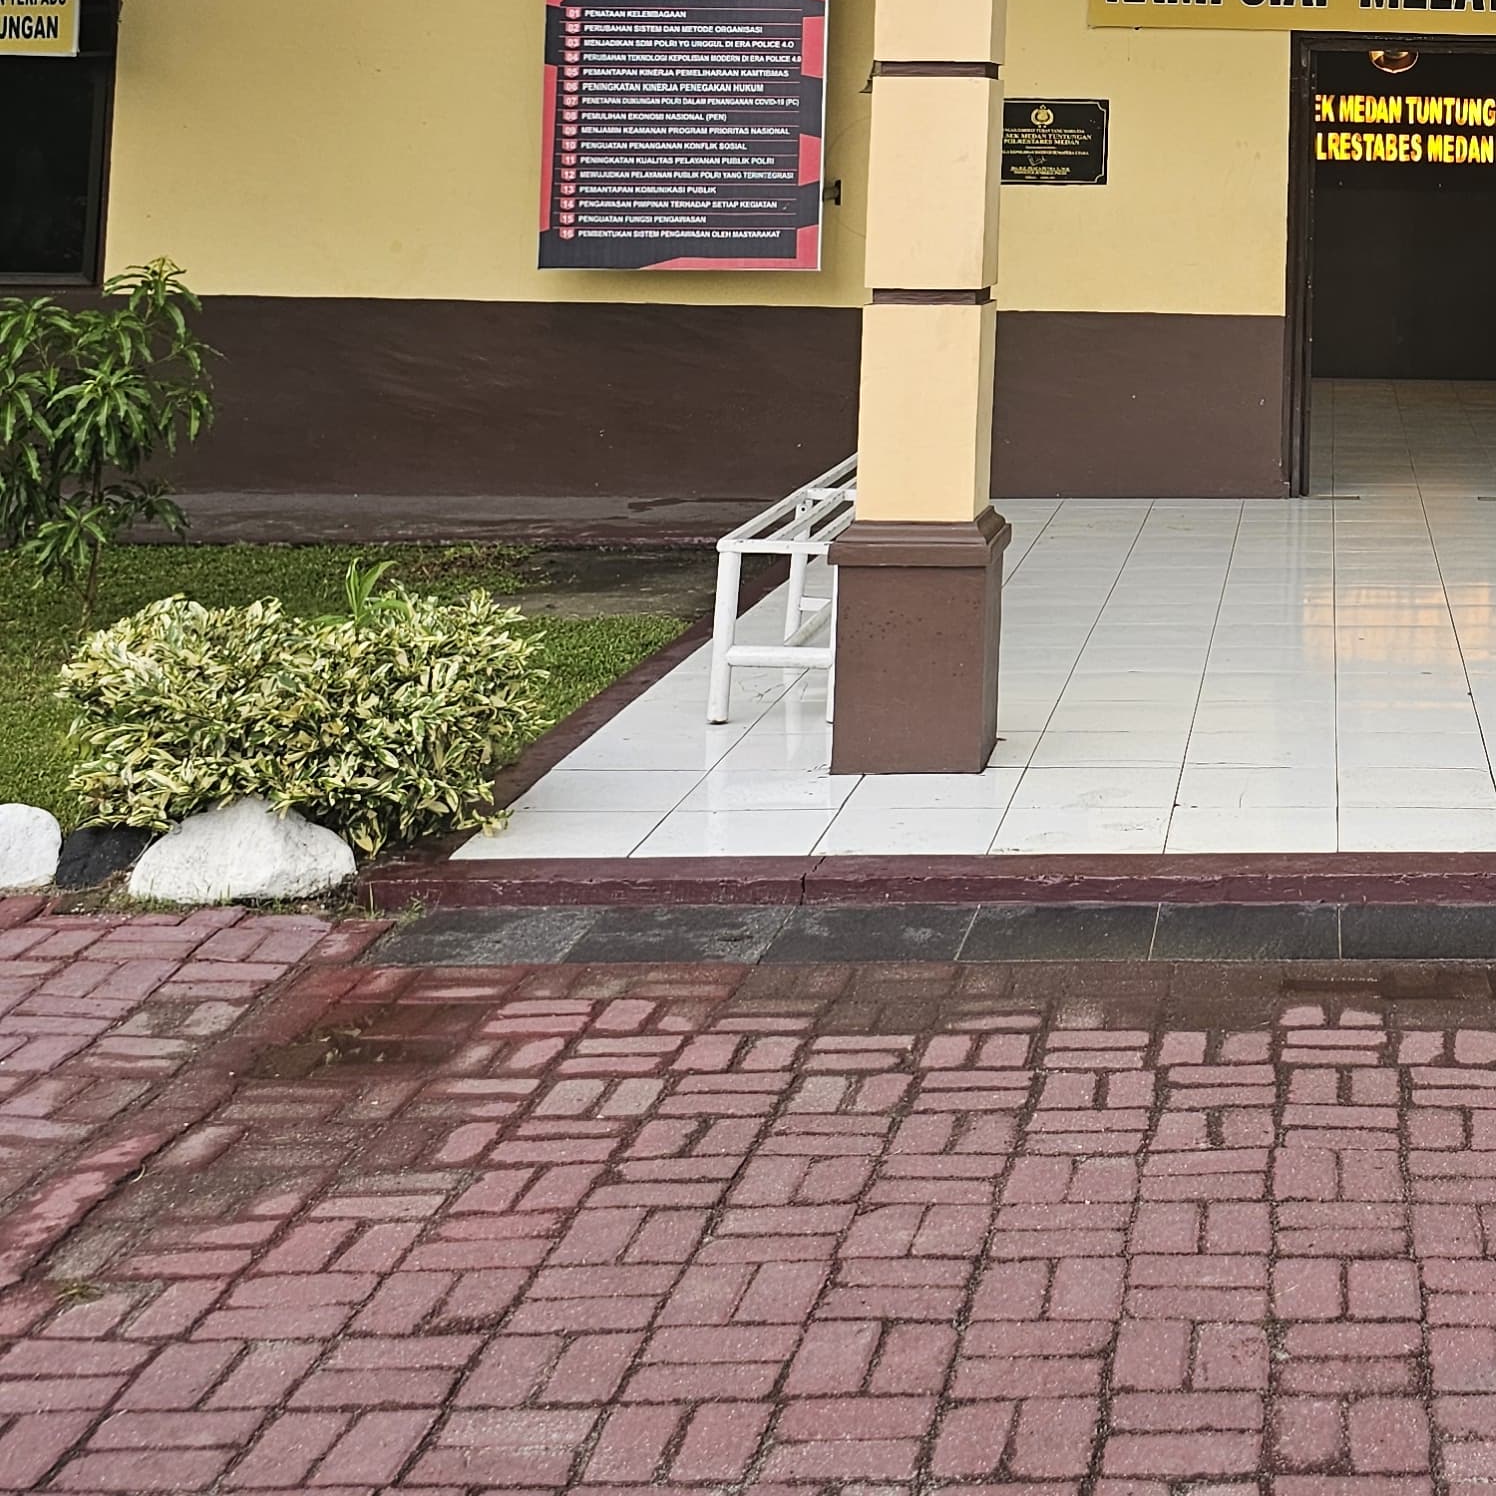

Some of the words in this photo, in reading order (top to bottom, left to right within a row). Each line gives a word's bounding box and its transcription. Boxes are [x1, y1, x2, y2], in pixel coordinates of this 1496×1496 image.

[663, 25, 680, 33] DAN
[680, 84, 731, 92] PENEGAKAN
[733, 84, 764, 92] HUKUM
[1339, 95, 1402, 124] MEDAN
[1316, 132, 1423, 162] LRESTABES
[1427, 134, 1494, 163] MEDAN
